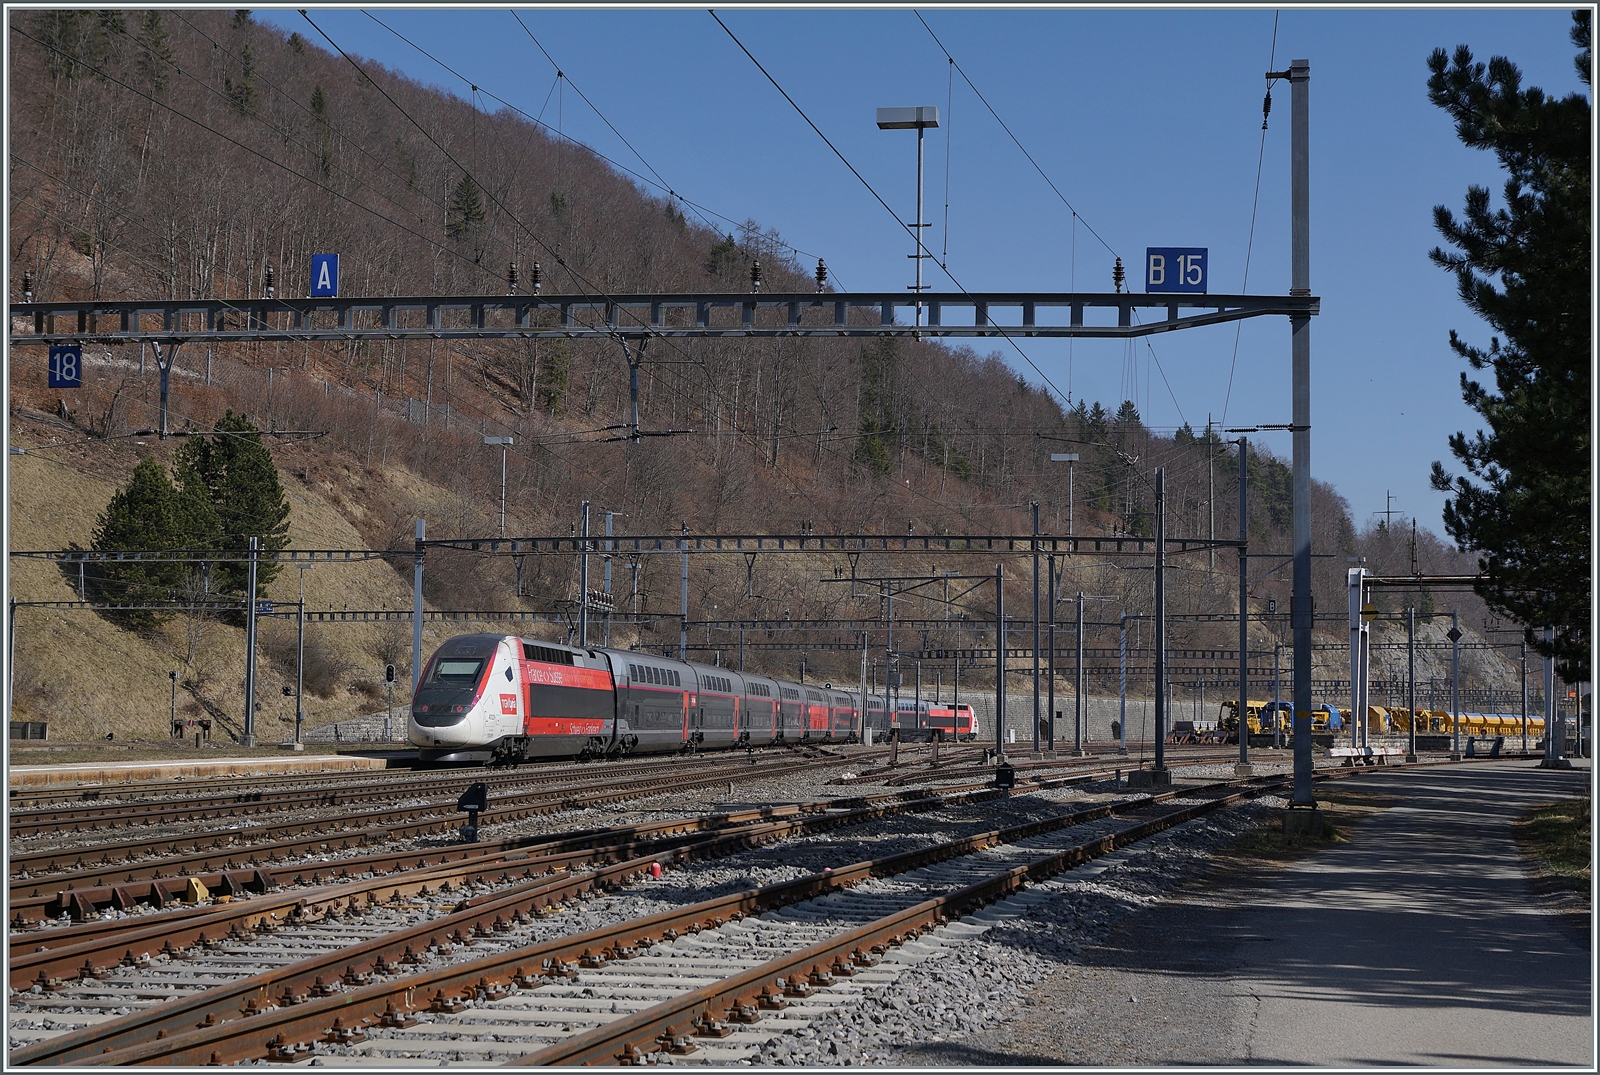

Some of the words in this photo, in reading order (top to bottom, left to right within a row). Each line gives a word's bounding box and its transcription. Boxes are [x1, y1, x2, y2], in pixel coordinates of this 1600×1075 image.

[317, 260, 331, 289] A
[1149, 255, 1165, 284] B
[1176, 255, 1203, 285] 15
[53, 352, 76, 381] 18
[527, 664, 544, 682] France
[548, 666, 563, 684] Suisse
